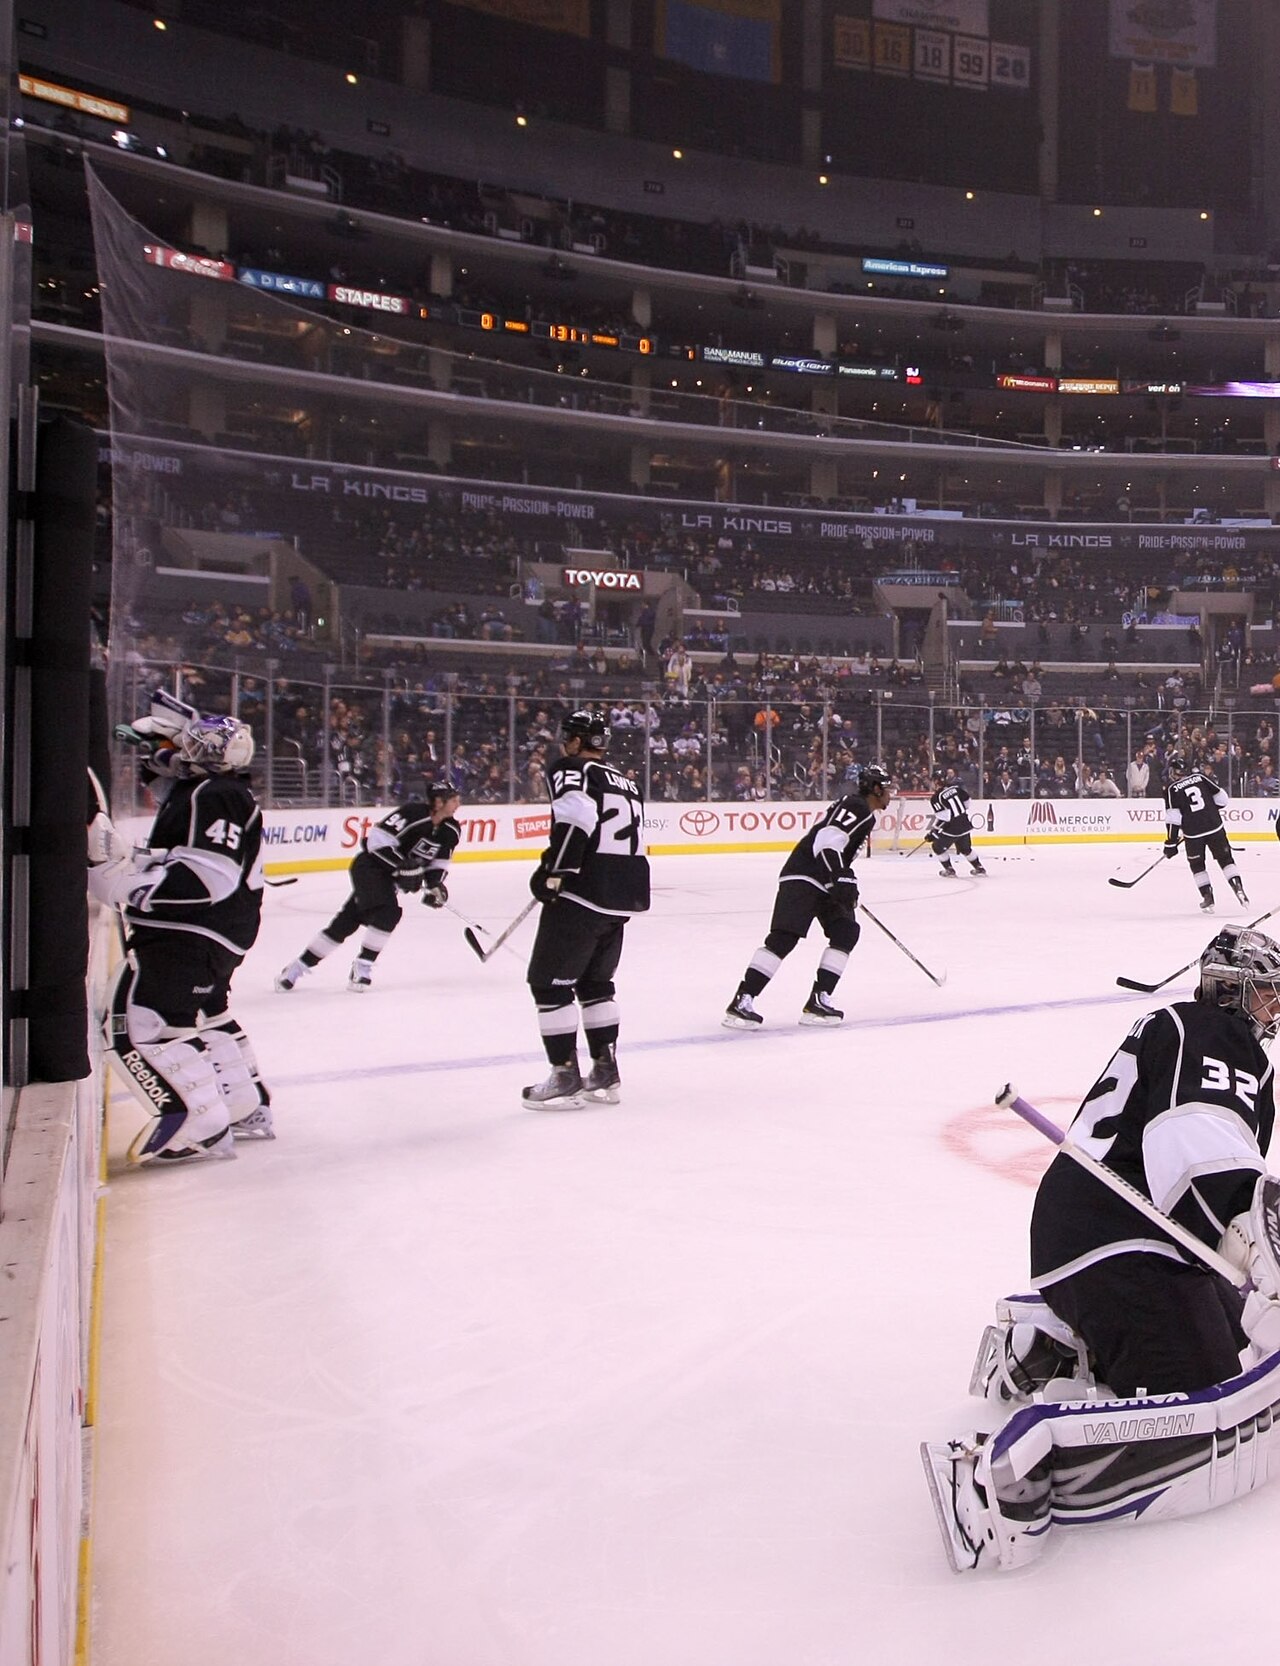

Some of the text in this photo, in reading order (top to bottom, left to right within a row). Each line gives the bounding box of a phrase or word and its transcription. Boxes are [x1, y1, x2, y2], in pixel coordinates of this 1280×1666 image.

[920, 45, 942, 68] 18
[959, 53, 983, 76] 99
[864, 260, 947, 275] American Express
[260, 275, 321, 296] DELTA
[334, 286, 402, 312] STAPLES
[704, 347, 722, 357] SAN
[728, 350, 763, 361] MANUEL
[772, 358, 797, 367] BUD
[800, 359, 831, 371] LIGHT
[839, 366, 876, 376] Panasonic
[291, 474, 330, 493] LA
[343, 478, 428, 504] KINGS
[682, 513, 793, 534] LA KINGS
[1012, 533, 1112, 547] LA KINGS
[566, 569, 640, 589] TOYOTA
[552, 770, 583, 794] 22
[605, 771, 639, 796] LEWIS
[1173, 774, 1203, 793] JOHNSON
[931, 801, 942, 812] 11
[948, 794, 967, 816] 11
[1185, 786, 1207, 812] 3
[384, 813, 408, 833] 94
[834, 807, 858, 827] 17
[1059, 815, 1112, 825] MERCURY
[1126, 810, 1166, 822] WEL
[1219, 809, 1254, 822] RGO
[205, 818, 243, 851] 45
[122, 1049, 173, 1108] Reebok
[1201, 1055, 1260, 1112] 32
[1083, 1413, 1195, 1444] VAUGHN
